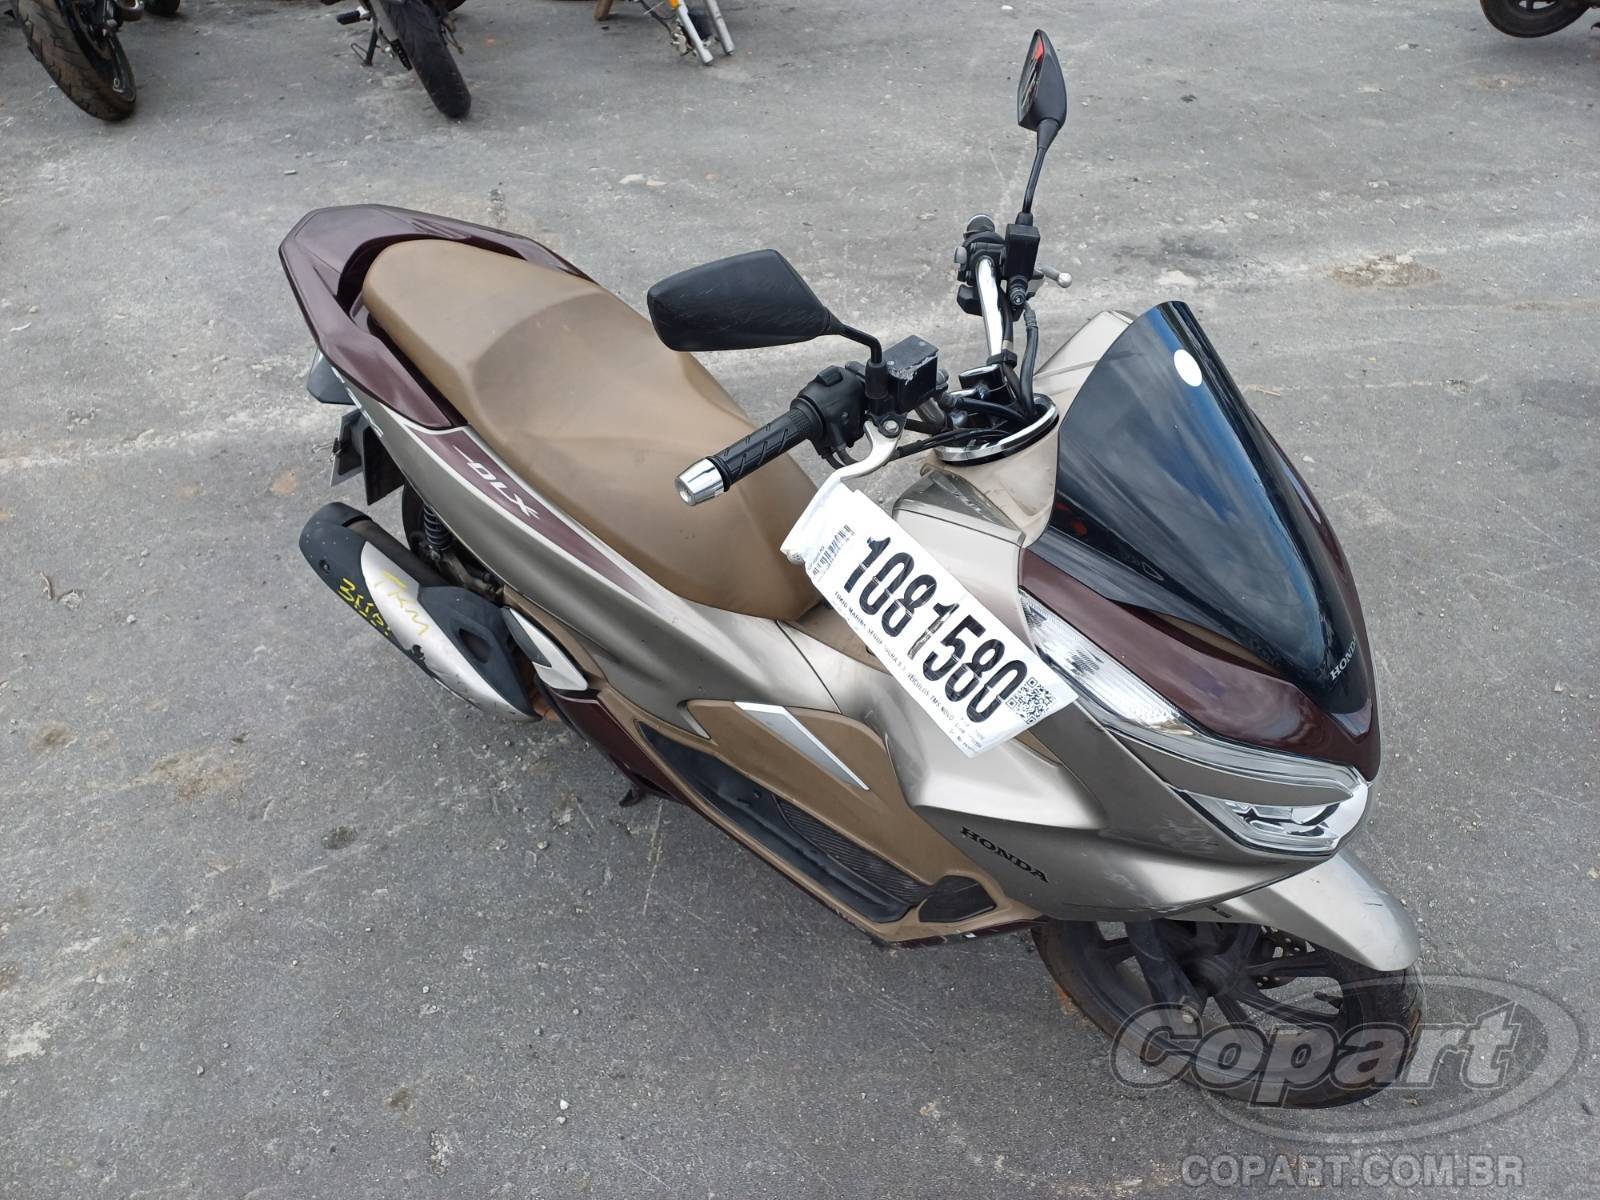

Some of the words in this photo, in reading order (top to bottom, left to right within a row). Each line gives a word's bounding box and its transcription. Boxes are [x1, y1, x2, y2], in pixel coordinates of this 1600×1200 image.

[465, 460, 541, 520] DLX
[844, 537, 1027, 722] 1081580
[1330, 638, 1356, 680] HOND
[960, 826, 1048, 883] HONDA
